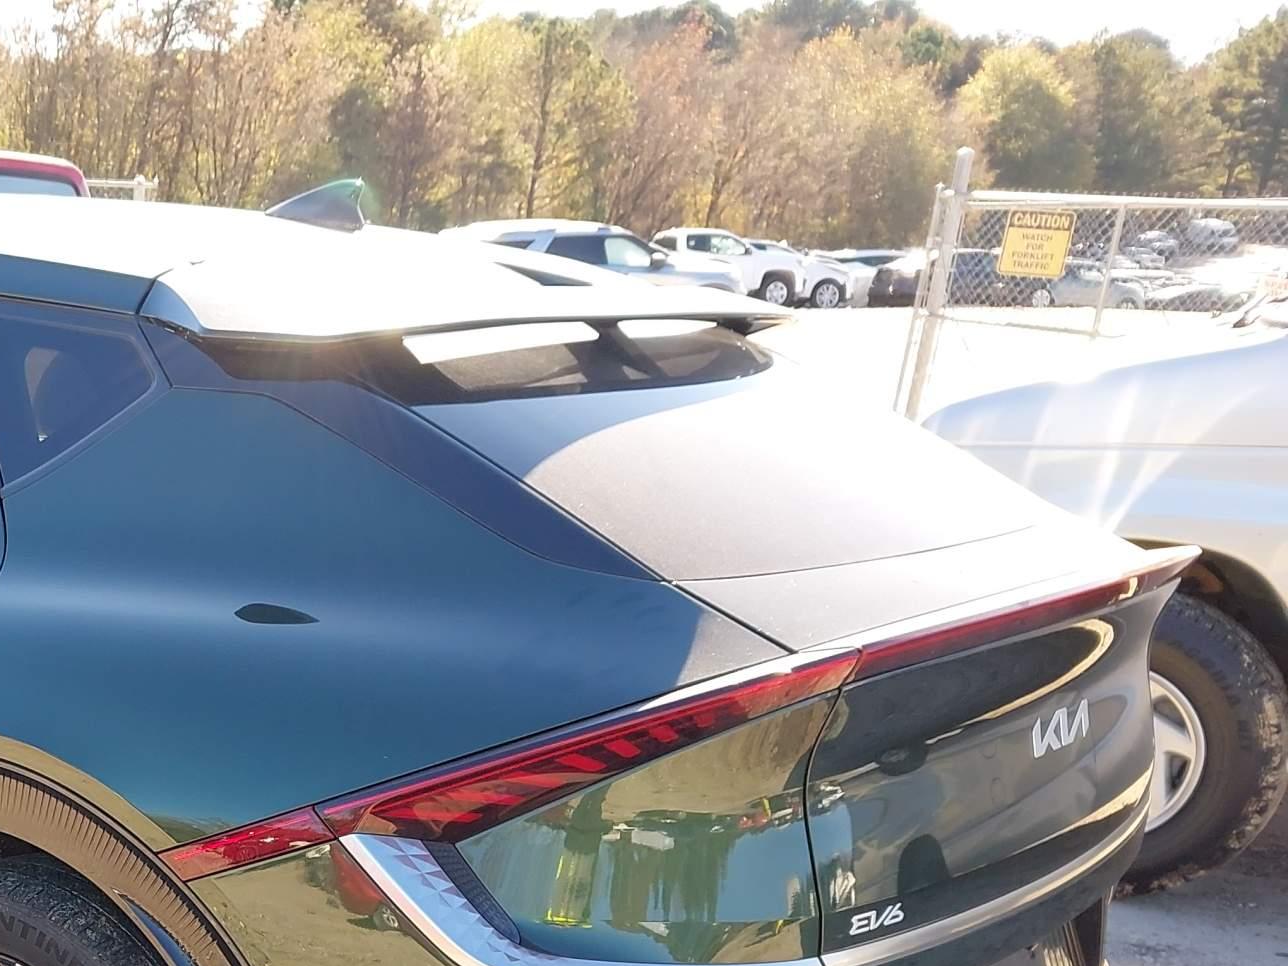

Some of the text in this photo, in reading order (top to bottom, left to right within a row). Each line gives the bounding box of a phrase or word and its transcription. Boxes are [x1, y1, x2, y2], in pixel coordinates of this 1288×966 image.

[1014, 212, 1070, 229] CAUTION
[1022, 233, 1053, 241] WATCH
[1011, 251, 1054, 261] FORKLIFT
[1013, 261, 1050, 270] TRAFFIC
[849, 902, 905, 936] EV6
